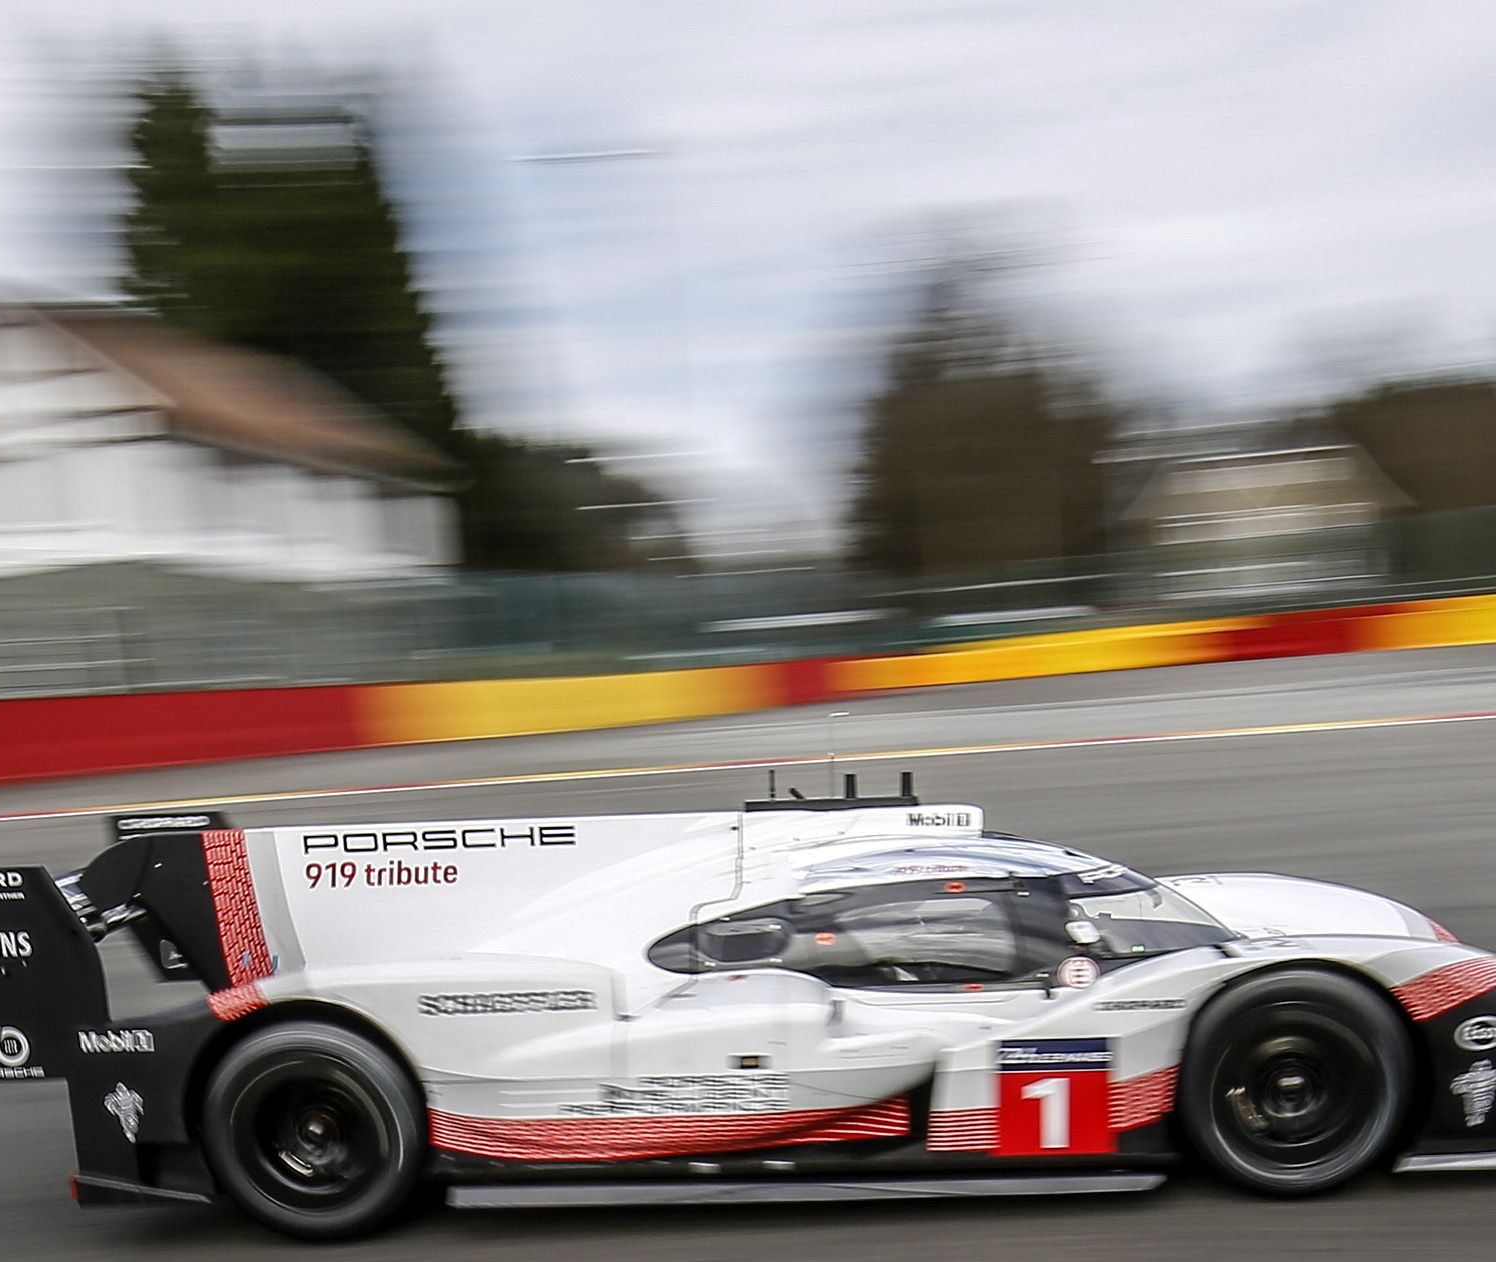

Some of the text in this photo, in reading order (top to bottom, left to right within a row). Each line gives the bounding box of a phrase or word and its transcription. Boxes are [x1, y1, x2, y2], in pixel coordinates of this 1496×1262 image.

[303, 825, 576, 854] PORSCHE
[305, 860, 458, 888] 919 tribute
[1021, 1077, 1071, 1149] 1
